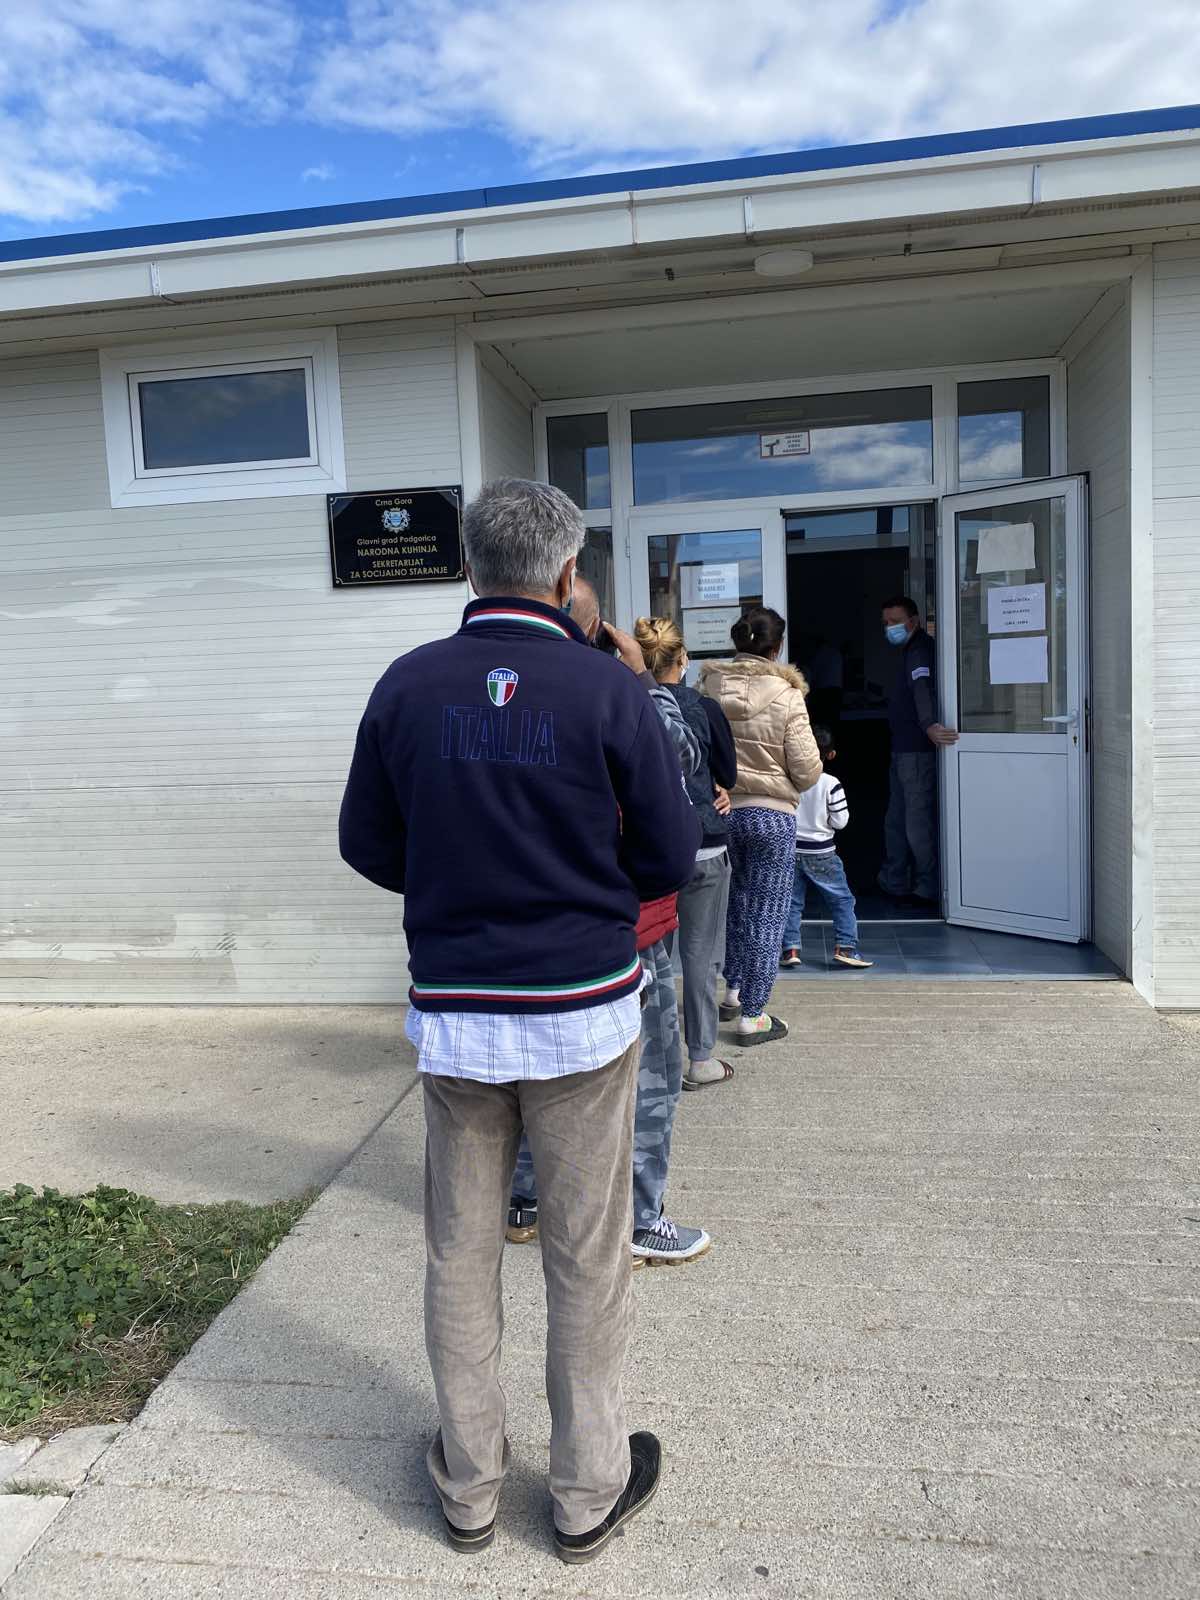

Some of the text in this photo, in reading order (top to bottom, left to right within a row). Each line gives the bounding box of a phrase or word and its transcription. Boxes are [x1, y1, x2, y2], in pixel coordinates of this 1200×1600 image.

[357, 535, 436, 545] Glavni grad Podgorica
[357, 544, 437, 557] NARODNA KUHINJA
[372, 558, 424, 568] SEKRETARIJAT
[362, 568, 407, 578] SOCIJALNO
[409, 566, 448, 576] STARANJE
[491, 672, 515, 681] ITALIA
[440, 705, 557, 766] ITALIA
